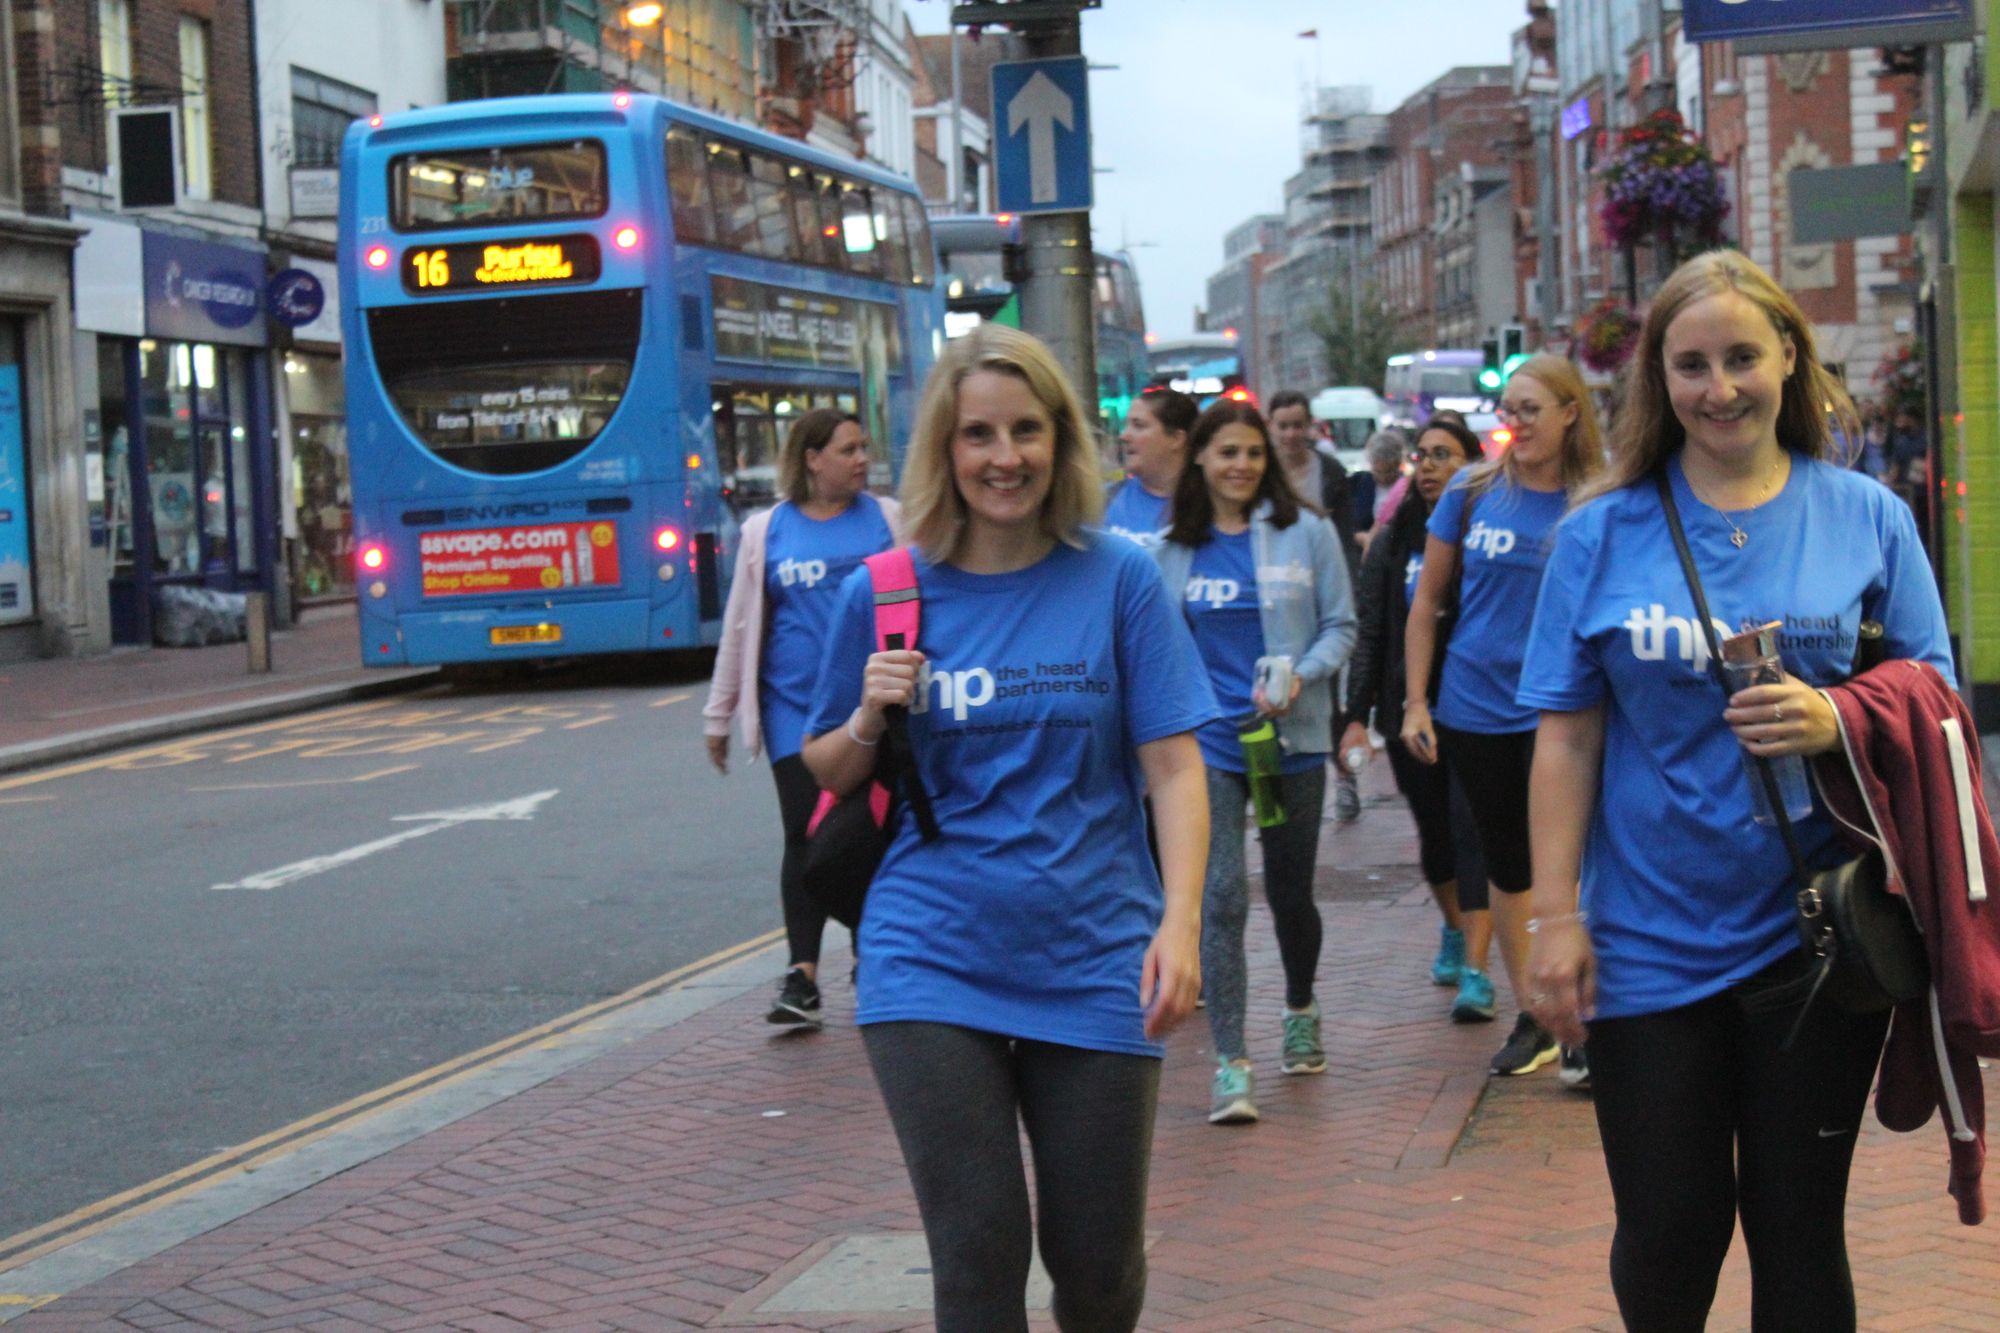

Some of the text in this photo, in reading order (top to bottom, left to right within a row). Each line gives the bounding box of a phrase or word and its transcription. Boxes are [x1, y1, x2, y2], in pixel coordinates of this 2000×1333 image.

[361, 216, 387, 233] 231
[412, 244, 563, 287] 16 Purley
[481, 391, 517, 408] every
[537, 388, 570, 401] mins
[437, 413, 469, 430] from
[421, 528, 567, 555] 88vape.com
[423, 558, 486, 574] Premium
[777, 558, 827, 588] thp
[424, 574, 510, 589] Shop Online
[1785, 613, 1840, 629] head
[997, 661, 1087, 680] the head
[996, 677, 1110, 702] partnership
